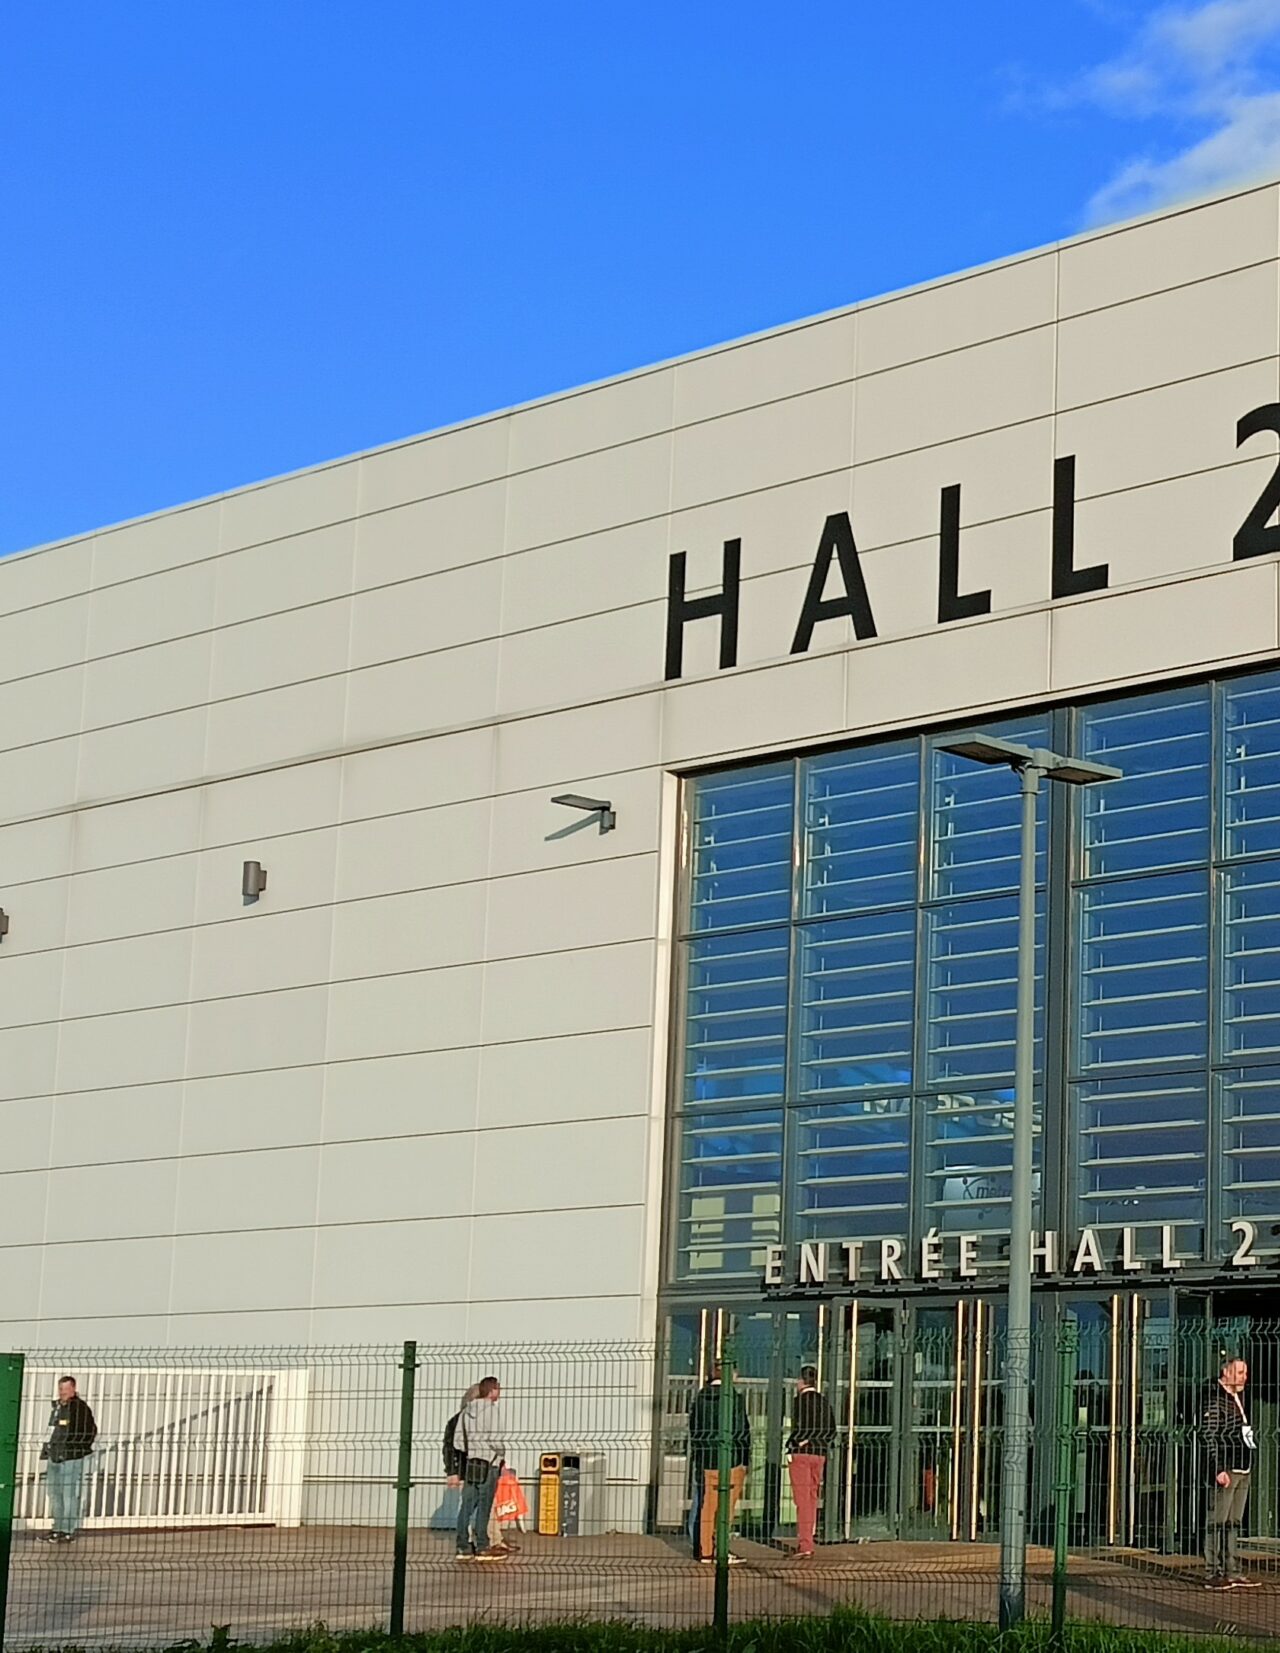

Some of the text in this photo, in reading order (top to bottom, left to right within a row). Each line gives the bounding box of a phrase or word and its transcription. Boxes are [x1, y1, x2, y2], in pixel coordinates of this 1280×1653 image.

[665, 455, 1109, 680] HALL
[765, 1227, 979, 1284] ENTRÉE
[1030, 1224, 1184, 1273] HALL
